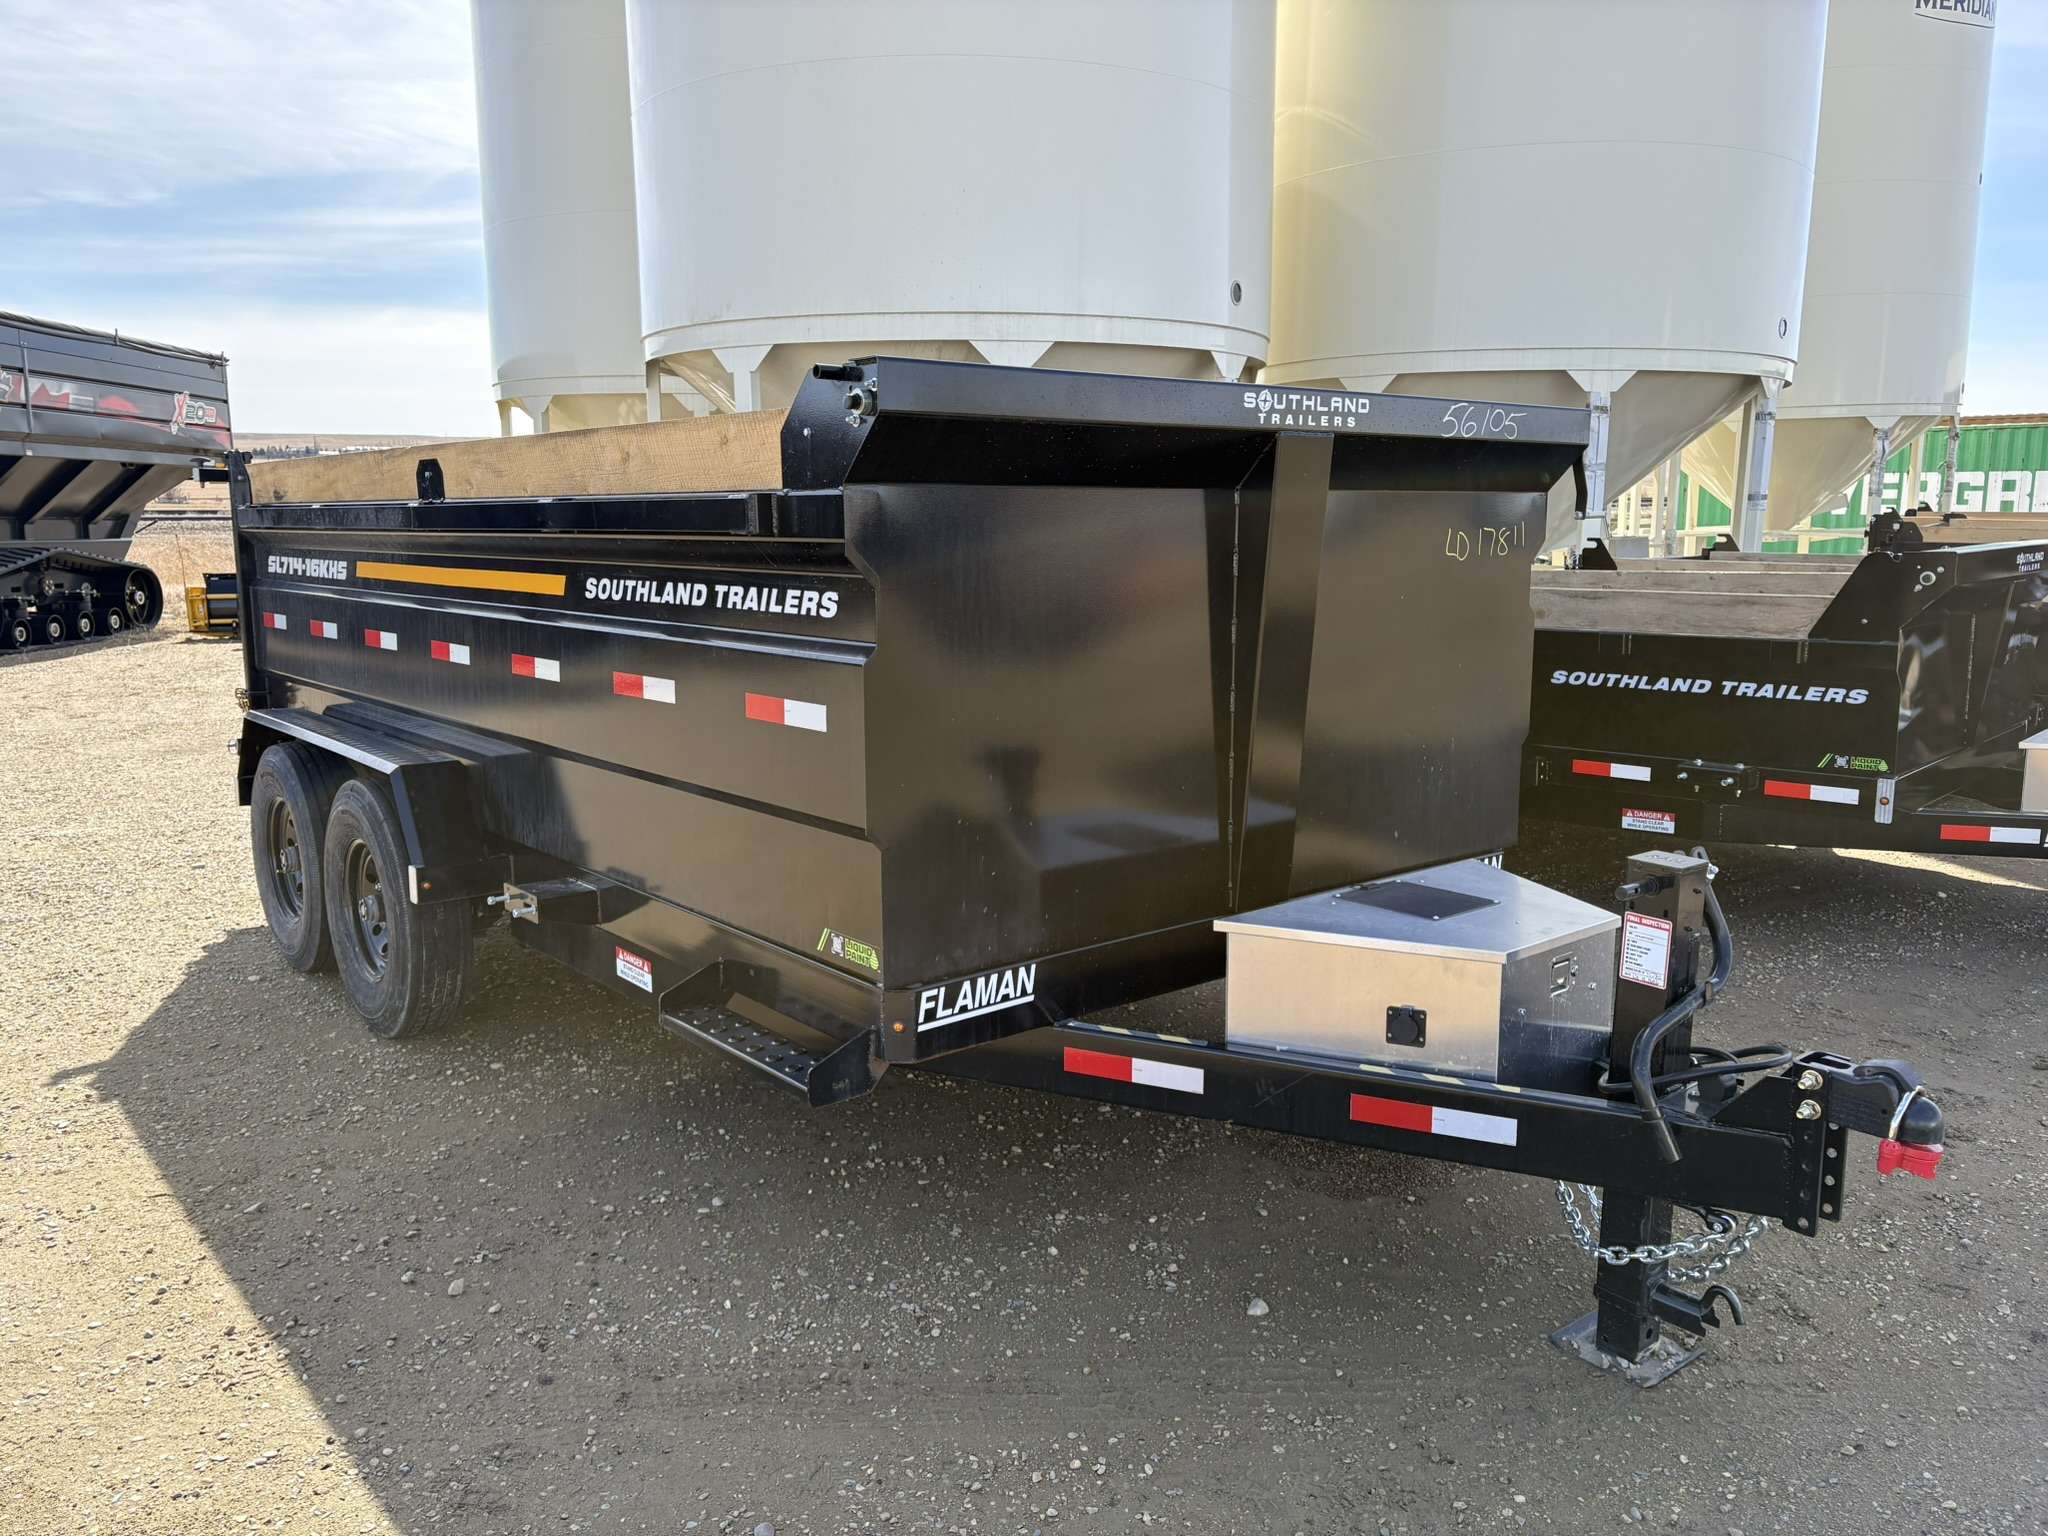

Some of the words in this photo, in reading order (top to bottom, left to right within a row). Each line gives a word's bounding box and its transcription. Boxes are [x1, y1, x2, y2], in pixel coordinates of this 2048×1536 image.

[1243, 389, 1370, 414] SOUTHLAND
[1258, 413, 1356, 428] TRAILERS
[1441, 402, 1527, 440] 56105
[585, 577, 707, 606] SOUTHLAND
[715, 584, 839, 619] TRAILERS
[1550, 670, 1712, 693] SOUTHLAND
[1721, 681, 1869, 704] TRAILERS
[918, 963, 1037, 1025] FLAMAN
